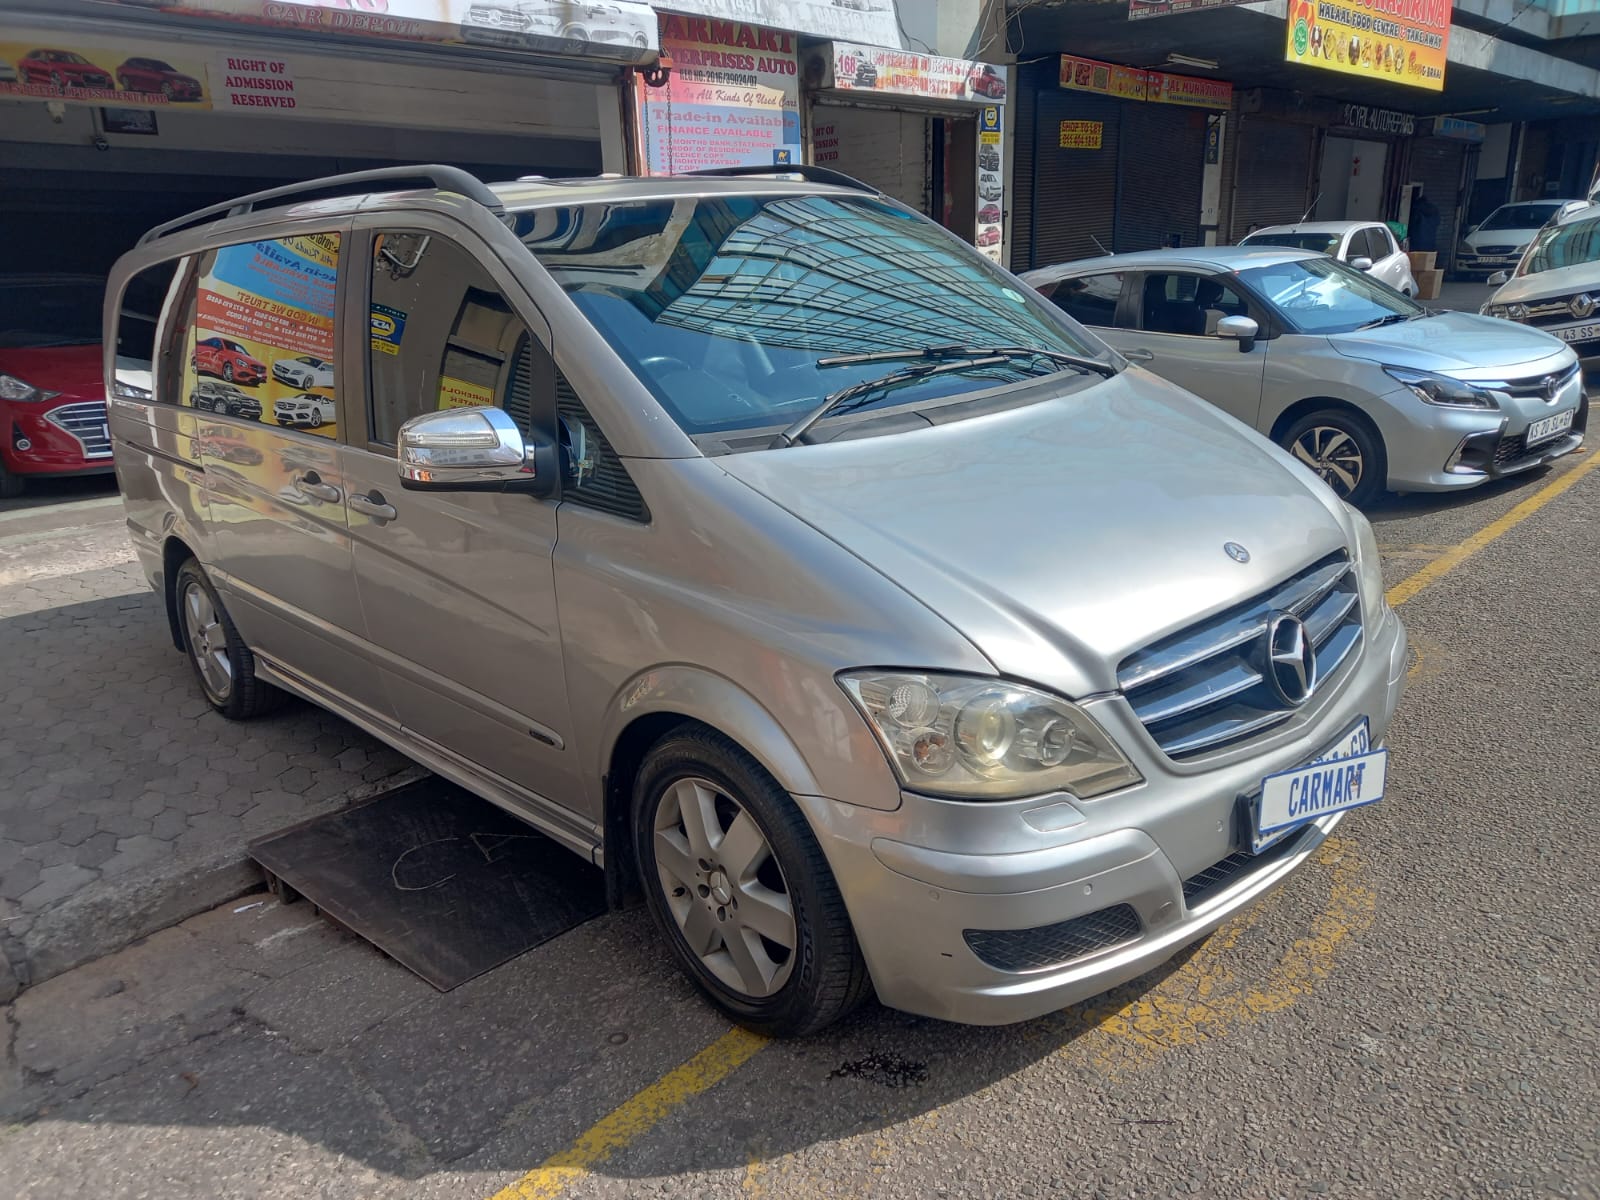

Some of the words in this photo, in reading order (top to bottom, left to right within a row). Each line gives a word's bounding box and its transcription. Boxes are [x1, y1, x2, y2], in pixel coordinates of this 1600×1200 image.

[263, 3, 323, 25] CAR
[330, 11, 423, 34] DEPOT
[1318, 3, 1351, 27] HALAAL
[1351, 12, 1372, 31] FOOD
[1373, 18, 1400, 38] CENTRE
[1406, 27, 1425, 45] TAKE
[1424, 33, 1443, 50] AWAY
[664, 14, 796, 54] ARMART
[227, 58, 267, 73] RIGHT
[271, 62, 286, 74] OF
[671, 48, 755, 72] TERPRISES
[757, 56, 797, 76] AUTO
[838, 55, 856, 74] 168
[225, 76, 295, 92] ADMISSION
[231, 93, 297, 109] RESERVED
[694, 88, 713, 101] All
[715, 89, 741, 103] Kinds
[743, 92, 754, 106] Of
[756, 93, 777, 106] Used
[778, 95, 798, 108] Cars
[652, 108, 722, 124] Trade-in
[727, 113, 796, 129] Available
[657, 125, 711, 136] FINANCE
[713, 127, 774, 139] AVAILABLE
[1563, 329, 1576, 340] 43
[1580, 326, 1593, 338] SS
[1288, 761, 1366, 818] CARMART
